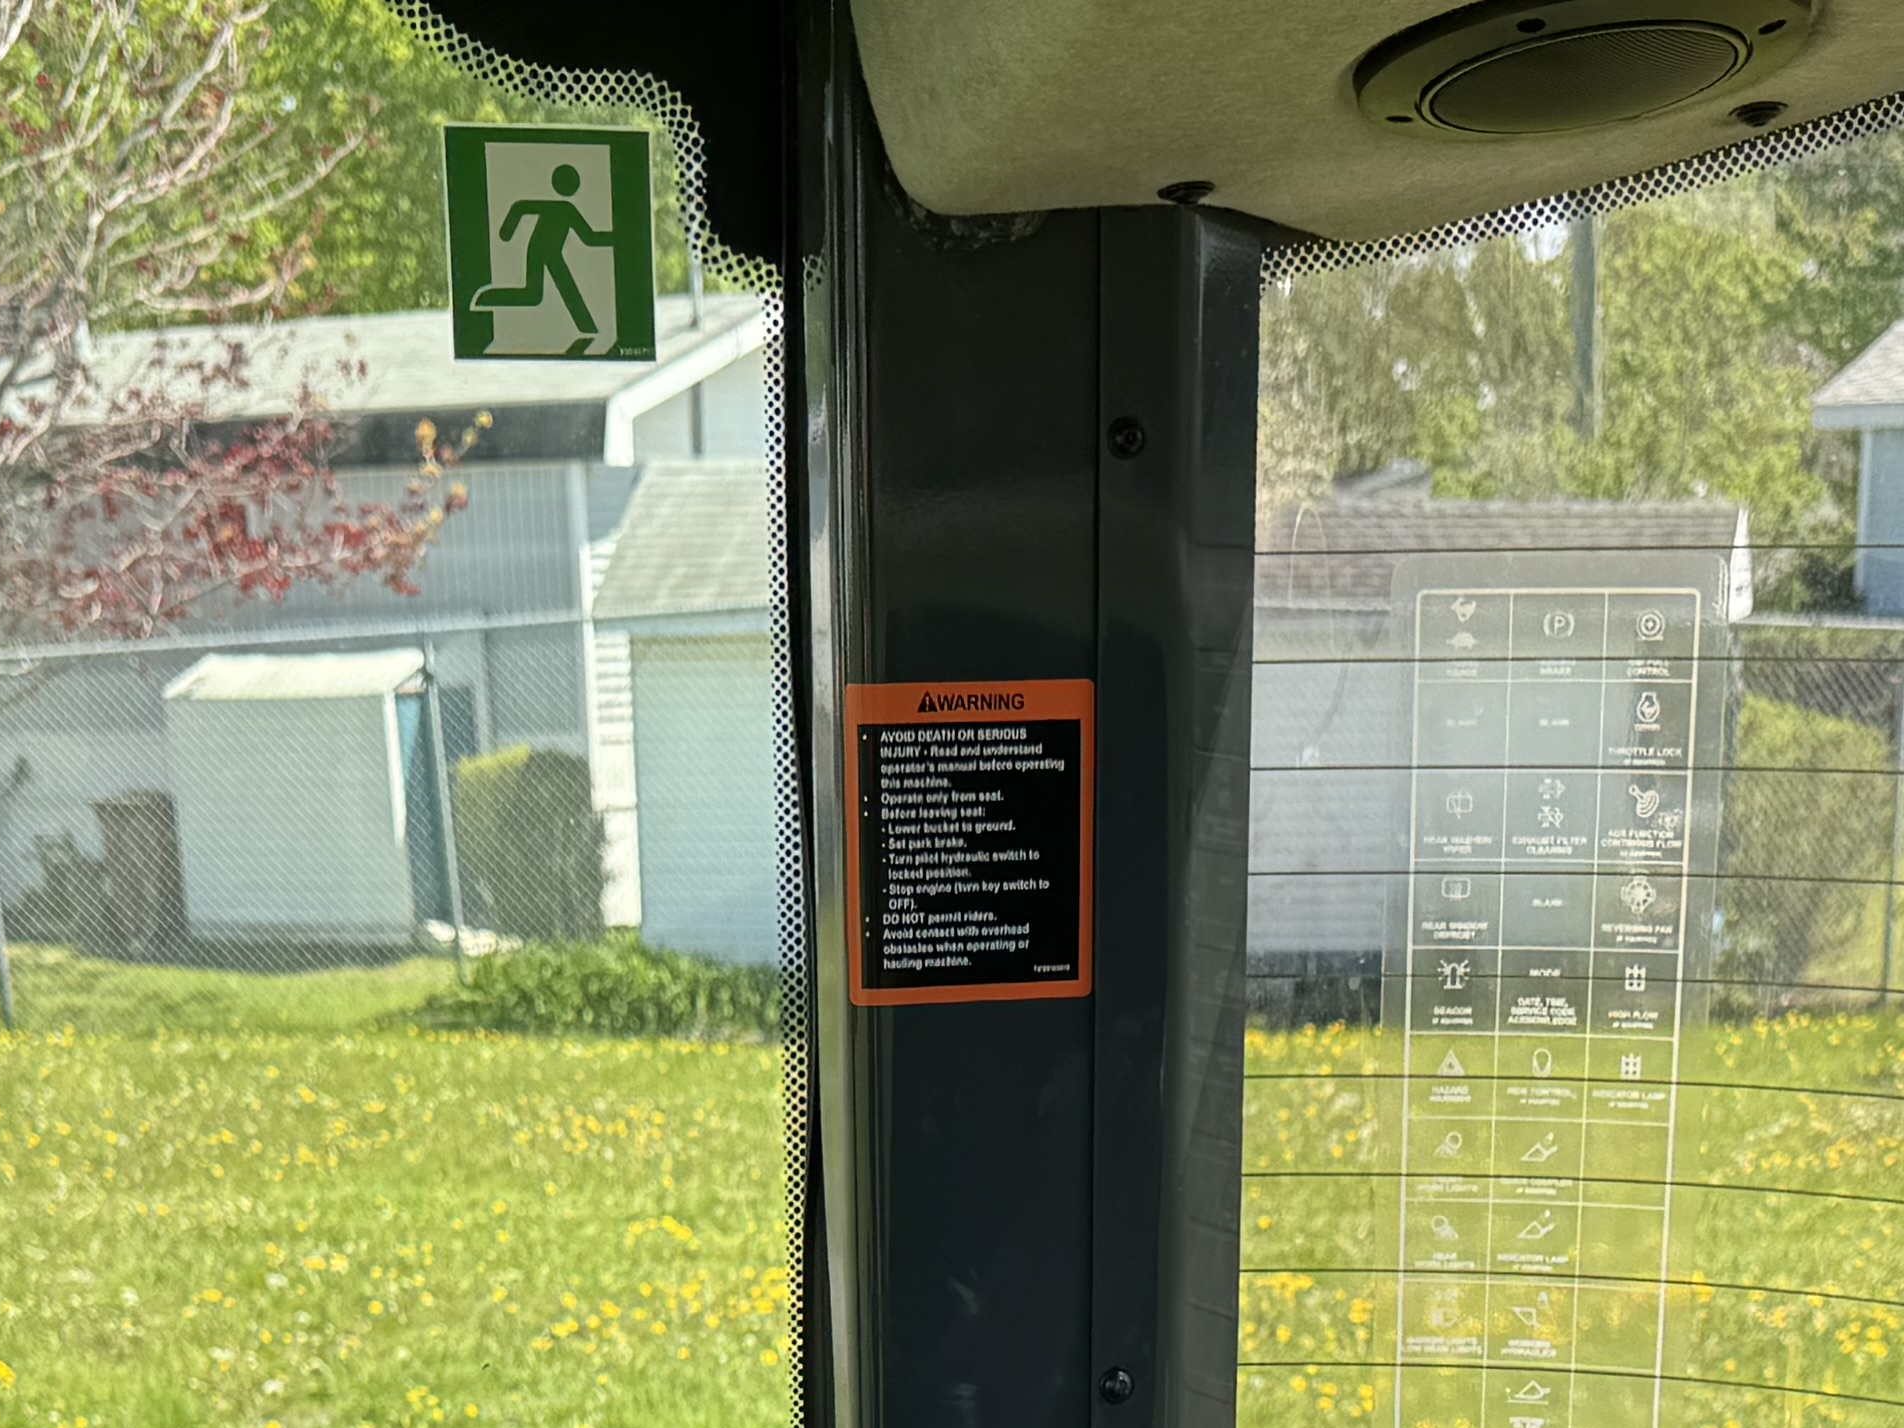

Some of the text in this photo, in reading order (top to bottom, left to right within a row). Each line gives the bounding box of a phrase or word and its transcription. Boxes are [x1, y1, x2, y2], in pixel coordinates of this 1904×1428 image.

[937, 693, 1024, 711] WARNING
[881, 727, 1026, 742] AVOID DEATH OR SERIOUS
[881, 746, 921, 758] INJURY
[930, 745, 957, 757] Read
[960, 744, 980, 756] and
[983, 743, 1042, 755] understand
[881, 758, 1064, 775] operator's manual before operating
[881, 776, 951, 789] this machine.
[881, 791, 1003, 806] Operate only from seat.
[882, 809, 916, 820] Before
[919, 808, 957, 820] leaving
[888, 823, 921, 835] Lower
[924, 822, 959, 834] bucket
[975, 820, 1015, 833] ground.
[889, 837, 967, 851] Set park brake.
[889, 855, 912, 865] Turn
[941, 853, 990, 865] hydraulic
[992, 850, 1026, 862] switch
[1029, 850, 1040, 860] to
[889, 868, 971, 880] locked position.
[889, 884, 913, 896] Stop
[916, 885, 952, 896] engine
[982, 881, 1000, 894] key
[1003, 880, 1036, 891] switch
[1039, 879, 1049, 889] to
[889, 899, 917, 910] OFF).
[883, 914, 899, 924] DO
[902, 912, 925, 924] NOT
[964, 911, 997, 922] riders.
[883, 928, 913, 940] Avoid
[982, 923, 1029, 936] overhead
[936, 942, 964, 953] when
[967, 940, 1016, 952] operating
[925, 956, 971, 968] machine.
